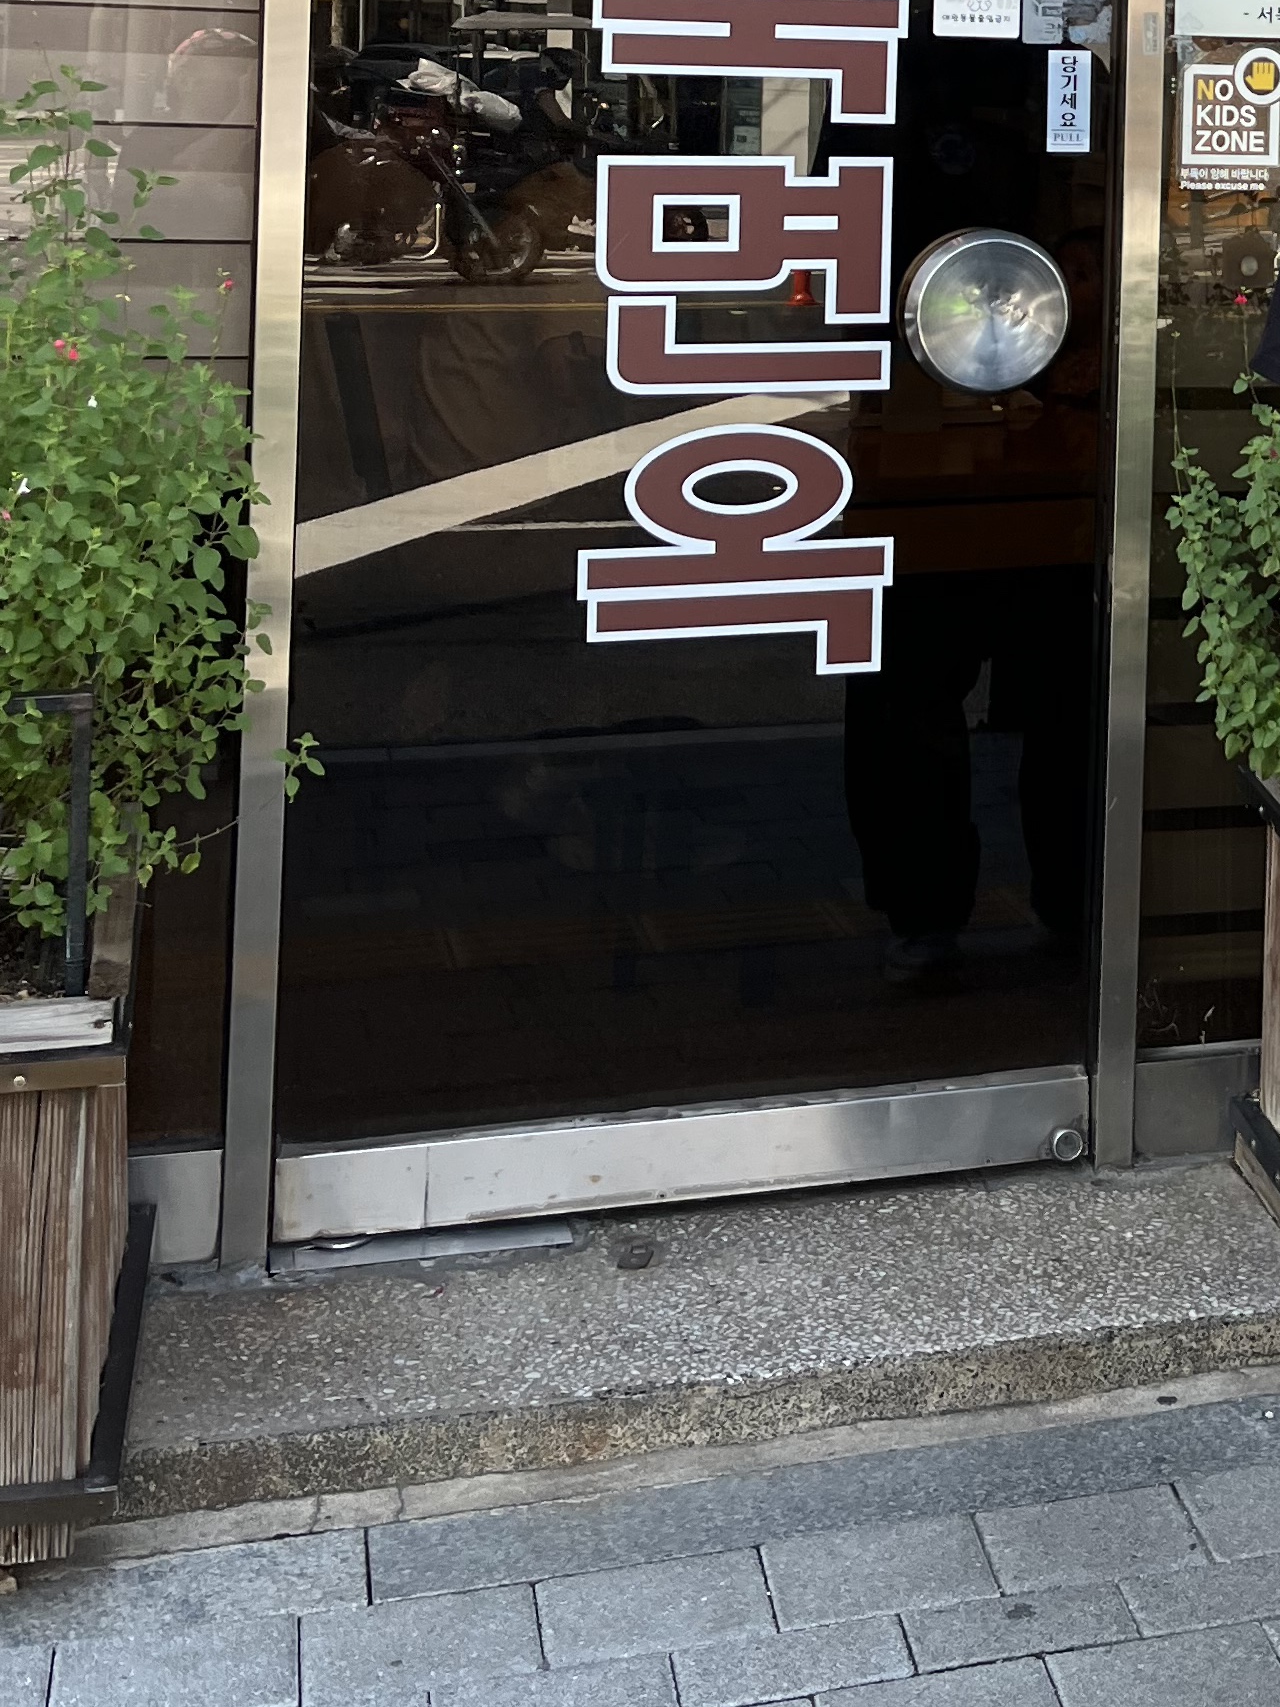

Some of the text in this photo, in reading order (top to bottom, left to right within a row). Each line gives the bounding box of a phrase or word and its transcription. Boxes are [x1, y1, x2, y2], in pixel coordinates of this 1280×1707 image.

[1061, 55, 1079, 127] 당기세요
[1197, 78, 1234, 102] NO
[1196, 104, 1257, 127] KIDS
[1053, 132, 1083, 142] PULL
[1194, 130, 1265, 152] ZONE
[1179, 180, 1213, 191] Please
[1214, 182, 1249, 191] excuse
[1210, 168, 1229, 181] 양해
